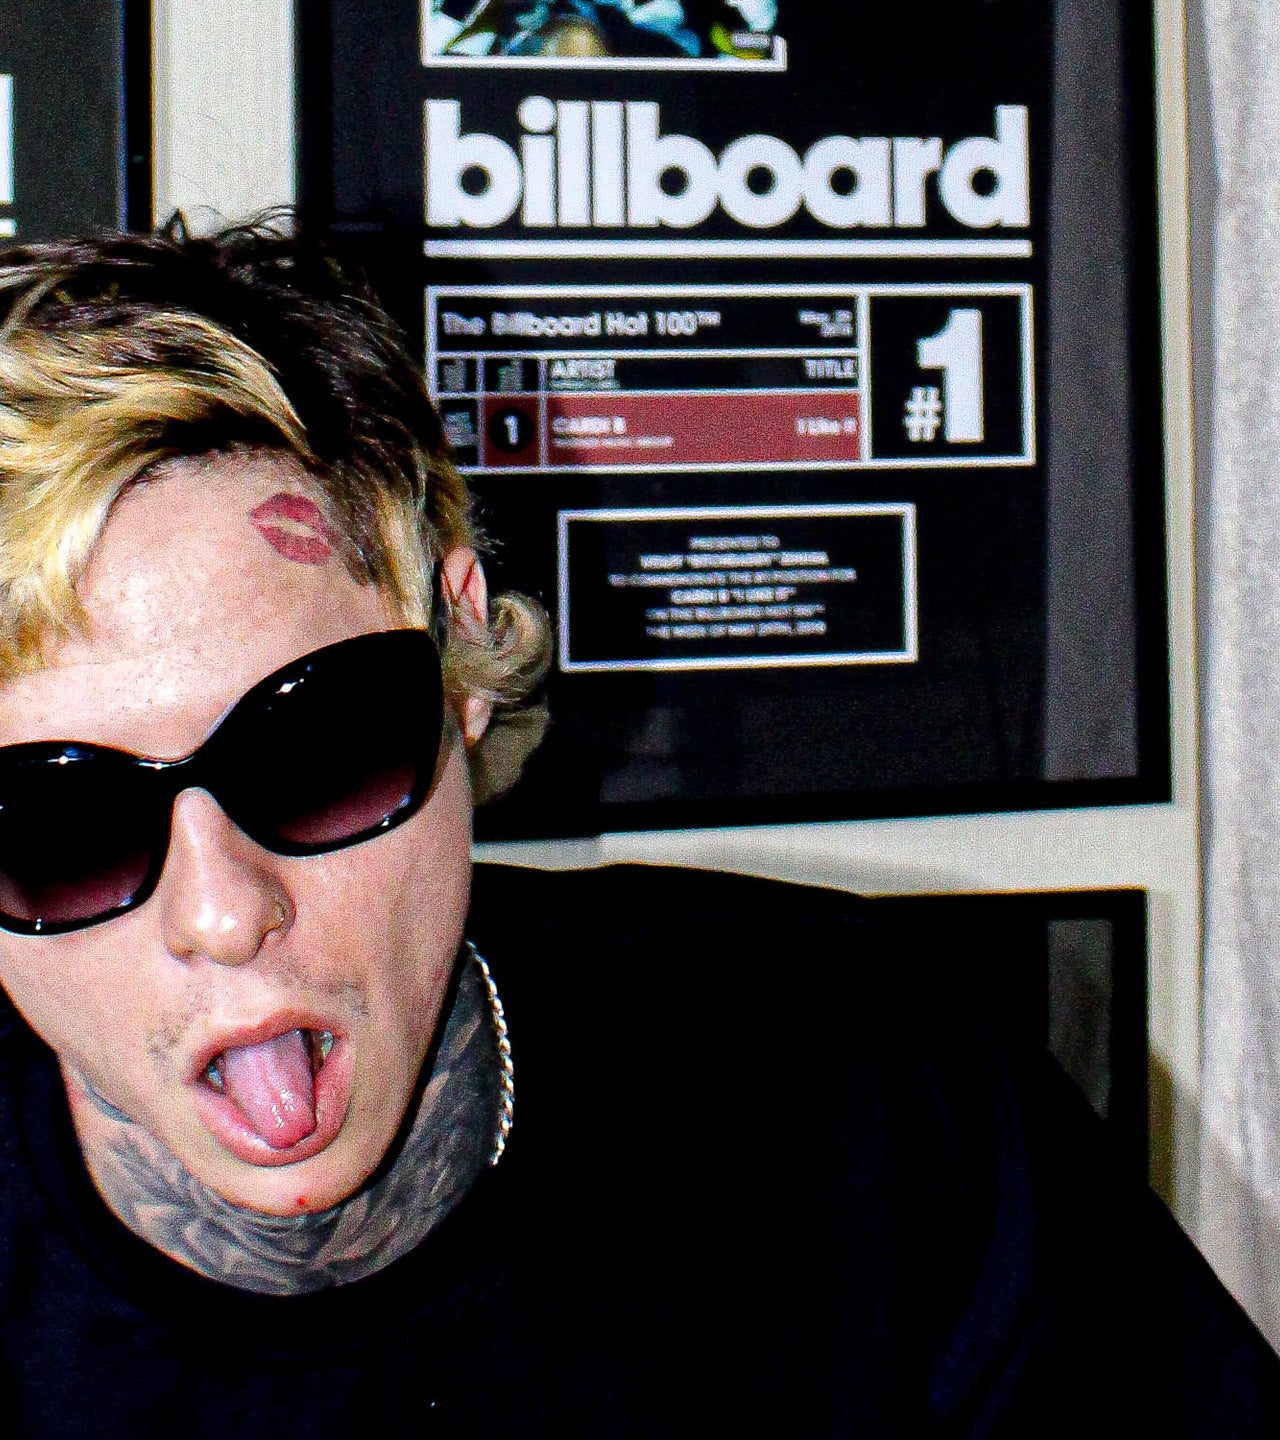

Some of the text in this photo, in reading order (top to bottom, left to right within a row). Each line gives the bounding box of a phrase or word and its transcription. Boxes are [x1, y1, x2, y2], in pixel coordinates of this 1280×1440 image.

[423, 96, 1031, 230] billboard
[441, 312, 486, 336] The
[491, 311, 601, 337] Billboard
[605, 311, 649, 335] Hot
[804, 358, 856, 379] TITLE
[905, 307, 985, 445] #1
[502, 417, 520, 446] 1
